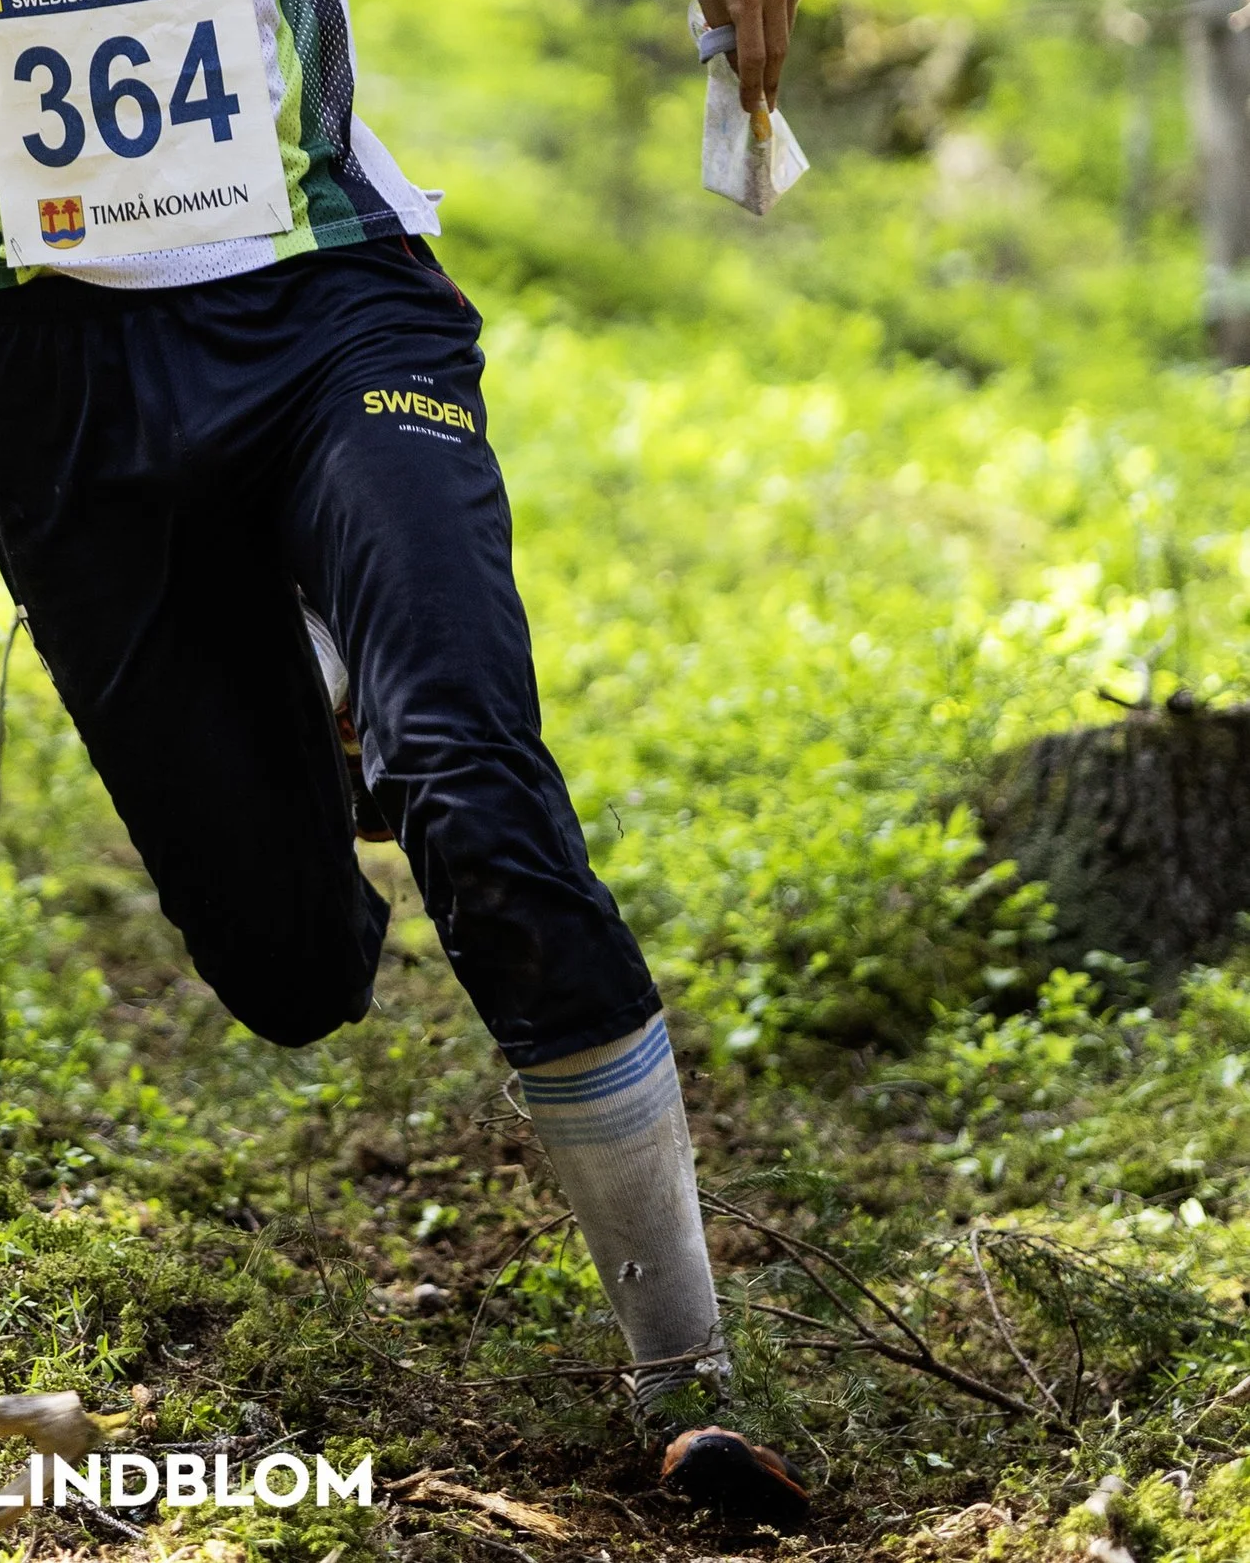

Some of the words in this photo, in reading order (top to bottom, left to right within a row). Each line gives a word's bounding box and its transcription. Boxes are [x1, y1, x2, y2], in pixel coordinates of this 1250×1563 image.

[13, 19, 240, 168] 364
[89, 193, 150, 226] TIMRÅ
[153, 184, 250, 218] KOMMUN
[362, 389, 476, 433] SWEDEN
